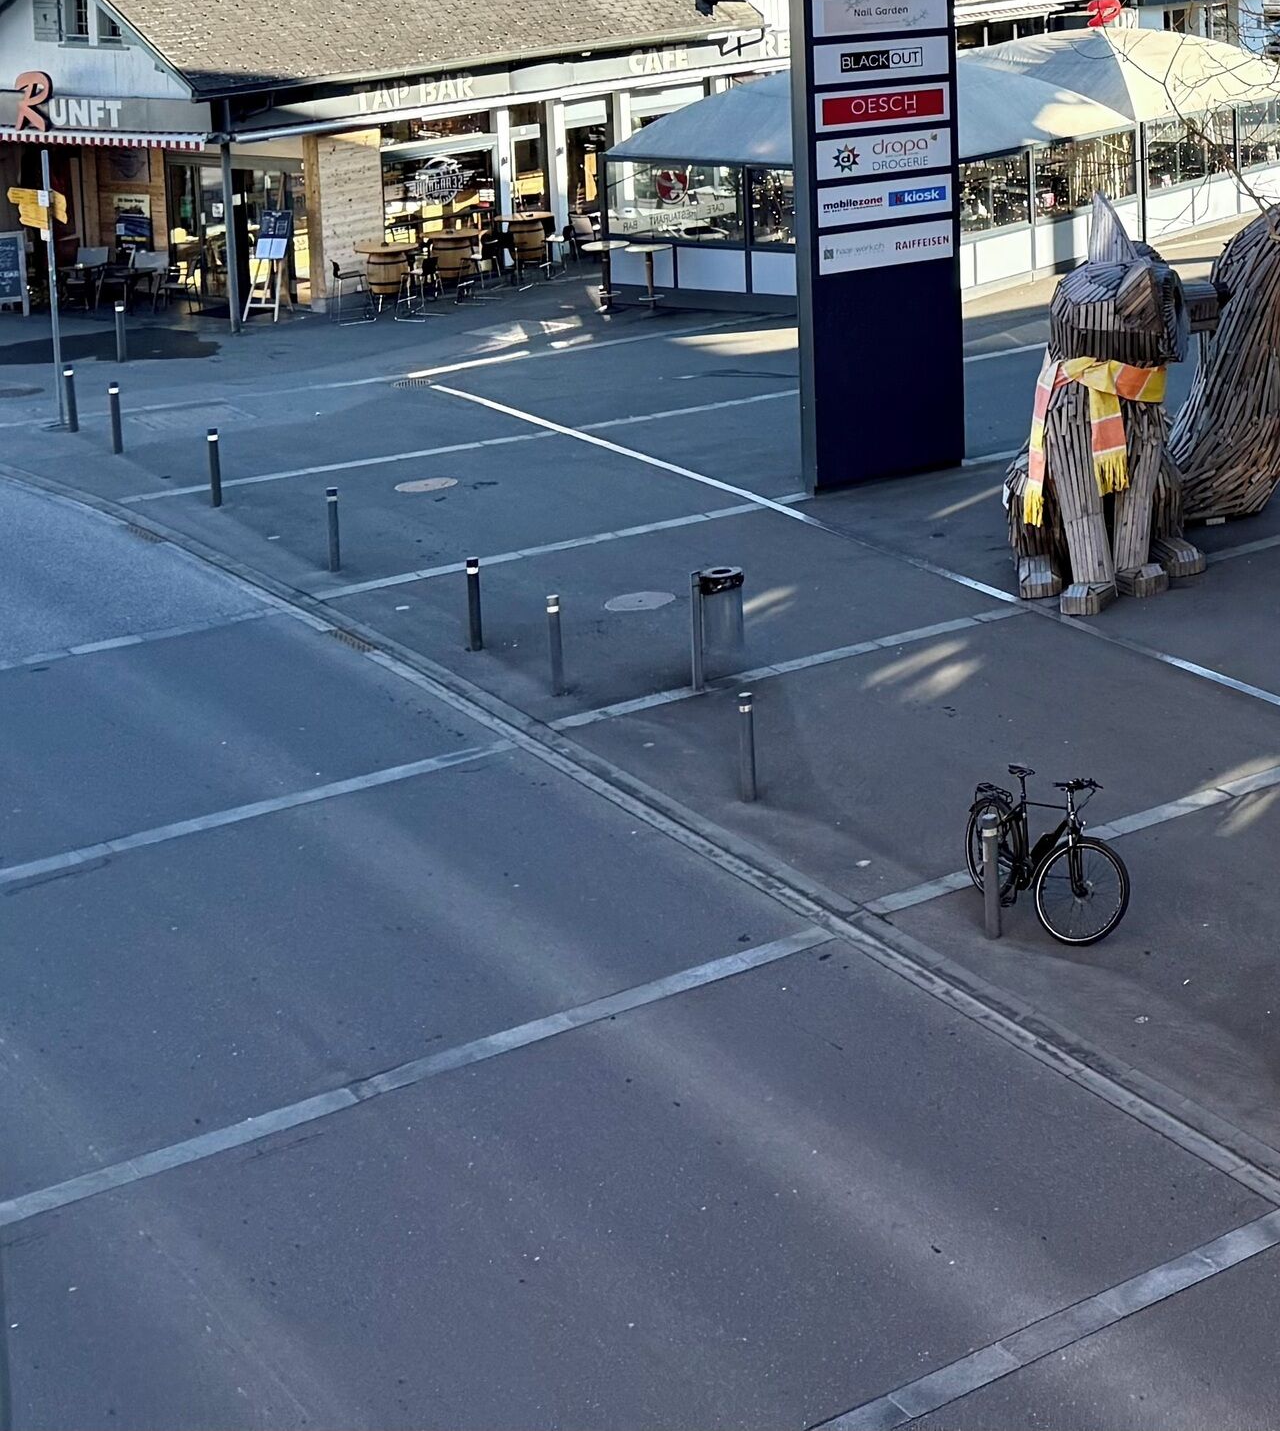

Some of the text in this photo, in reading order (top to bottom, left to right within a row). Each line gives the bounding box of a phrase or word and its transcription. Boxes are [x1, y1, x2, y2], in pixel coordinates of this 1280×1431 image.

[875, 6, 908, 16] Garden
[628, 43, 690, 74] CAFE
[15, 70, 122, 132] RUNFT
[353, 72, 475, 112] TAP BAR
[851, 94, 917, 115] OESCH
[872, 138, 929, 156] dropa
[872, 155, 929, 171] DROGERIE
[904, 189, 940, 203] kiosk
[895, 235, 950, 251] RAIFFEISEN
